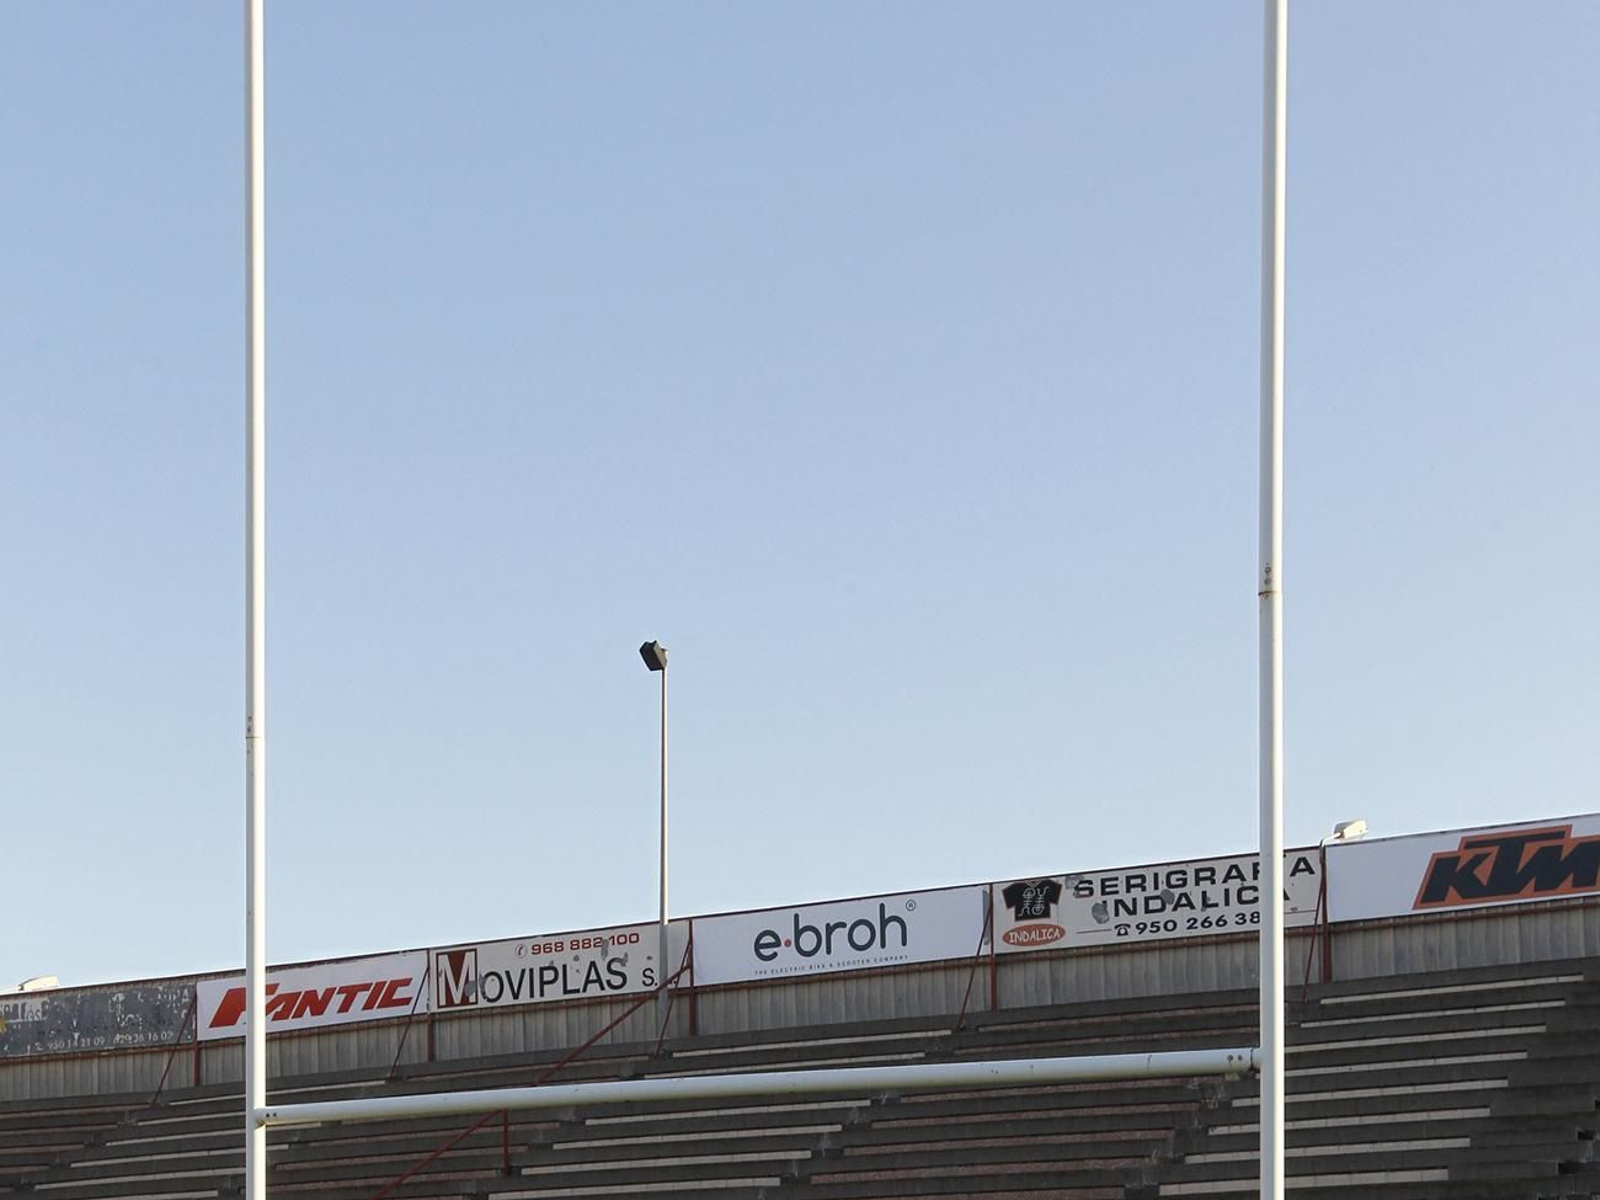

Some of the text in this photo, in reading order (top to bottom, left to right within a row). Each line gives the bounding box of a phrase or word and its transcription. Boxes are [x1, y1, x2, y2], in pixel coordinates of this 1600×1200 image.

[1074, 856, 1315, 899] SERIGRAA
[1420, 831, 1600, 904] KTM
[1100, 884, 1290, 918] NDALIC
[1008, 928, 1062, 944] INDALICA
[1135, 911, 1260, 935] 950 266 38
[531, 932, 640, 955] 968 882 100
[209, 977, 414, 1029] FANTIC
